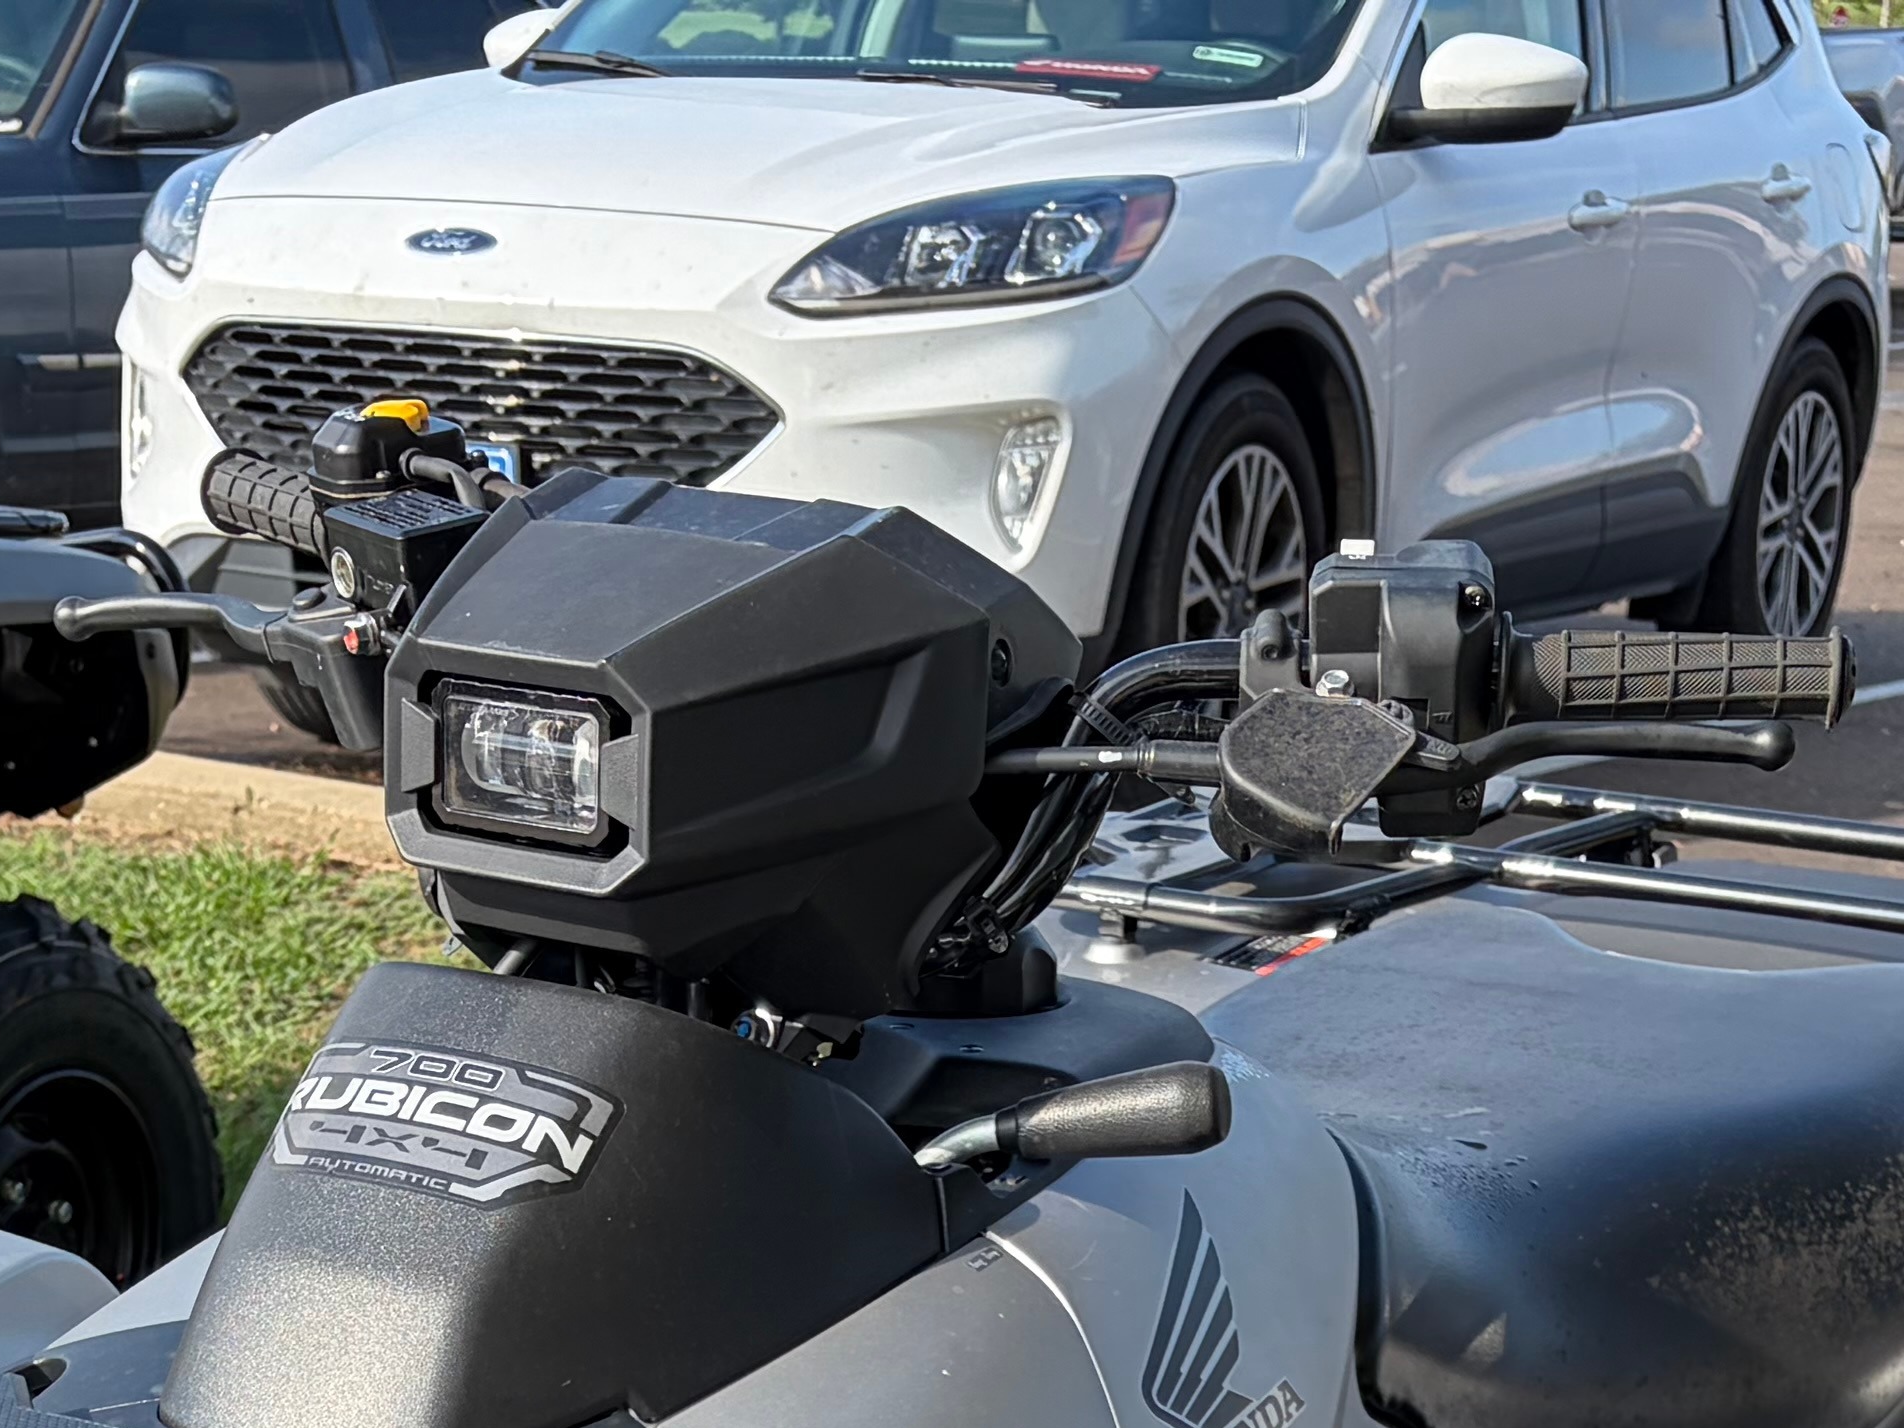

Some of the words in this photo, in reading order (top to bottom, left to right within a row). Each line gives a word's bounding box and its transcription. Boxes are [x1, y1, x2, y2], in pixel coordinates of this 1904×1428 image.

[369, 1048, 506, 1092] 700
[289, 1075, 594, 1175] RUBICON
[307, 1156, 448, 1191] AUTOMATIC
